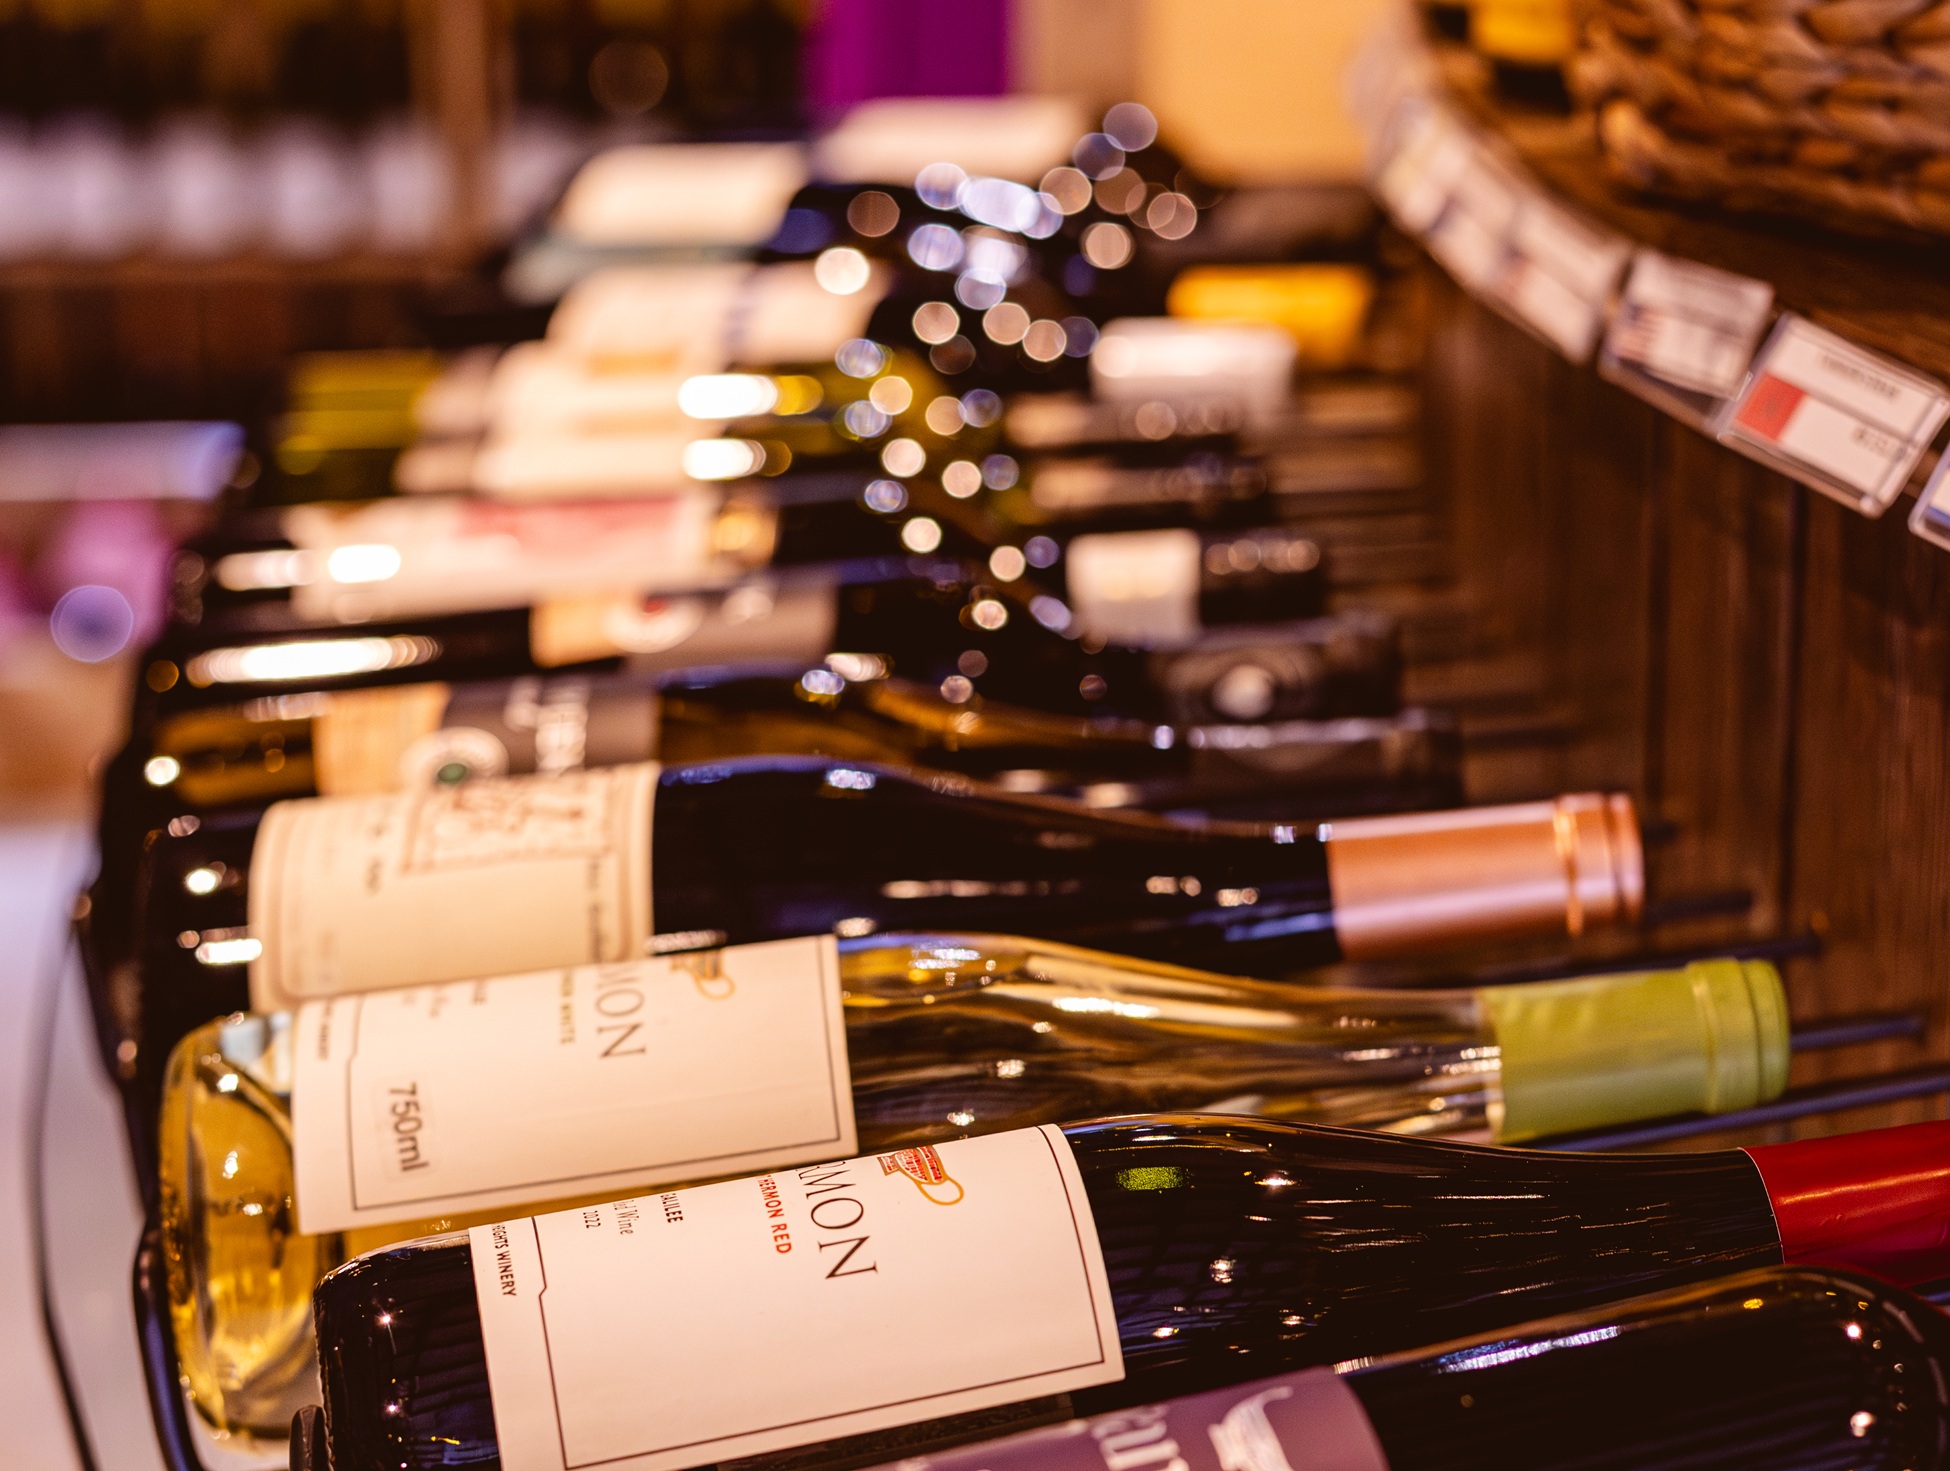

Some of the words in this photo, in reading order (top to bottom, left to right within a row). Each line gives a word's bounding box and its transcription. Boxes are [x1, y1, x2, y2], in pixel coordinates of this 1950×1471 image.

[389, 1081, 430, 1173] 750ml
[583, 1210, 601, 1229] 2022
[616, 1209, 640, 1236] Wine
[771, 1223, 792, 1254] RED
[496, 1250, 517, 1297] WINERY
